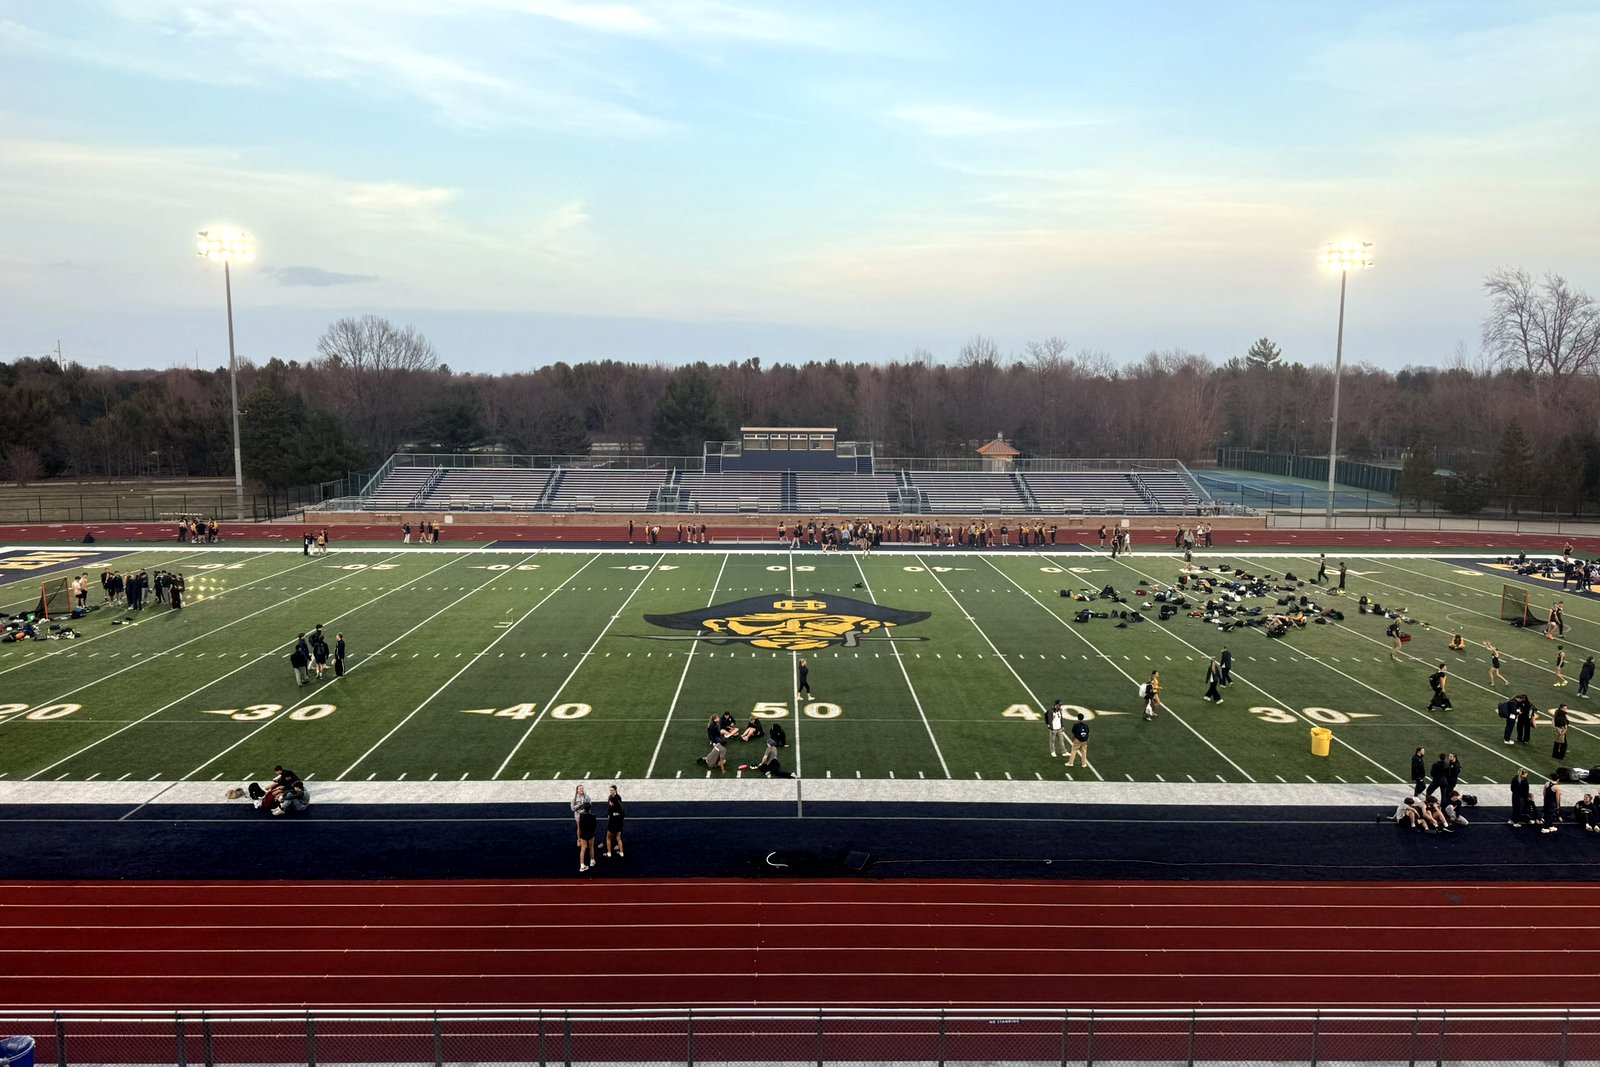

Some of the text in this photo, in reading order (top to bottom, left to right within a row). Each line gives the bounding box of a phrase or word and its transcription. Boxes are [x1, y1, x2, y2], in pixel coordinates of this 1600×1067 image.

[230, 704, 337, 721] 30
[494, 702, 592, 720] 40
[751, 702, 842, 719] 50
[1002, 704, 1096, 721] 40
[1249, 706, 1351, 723] 30
